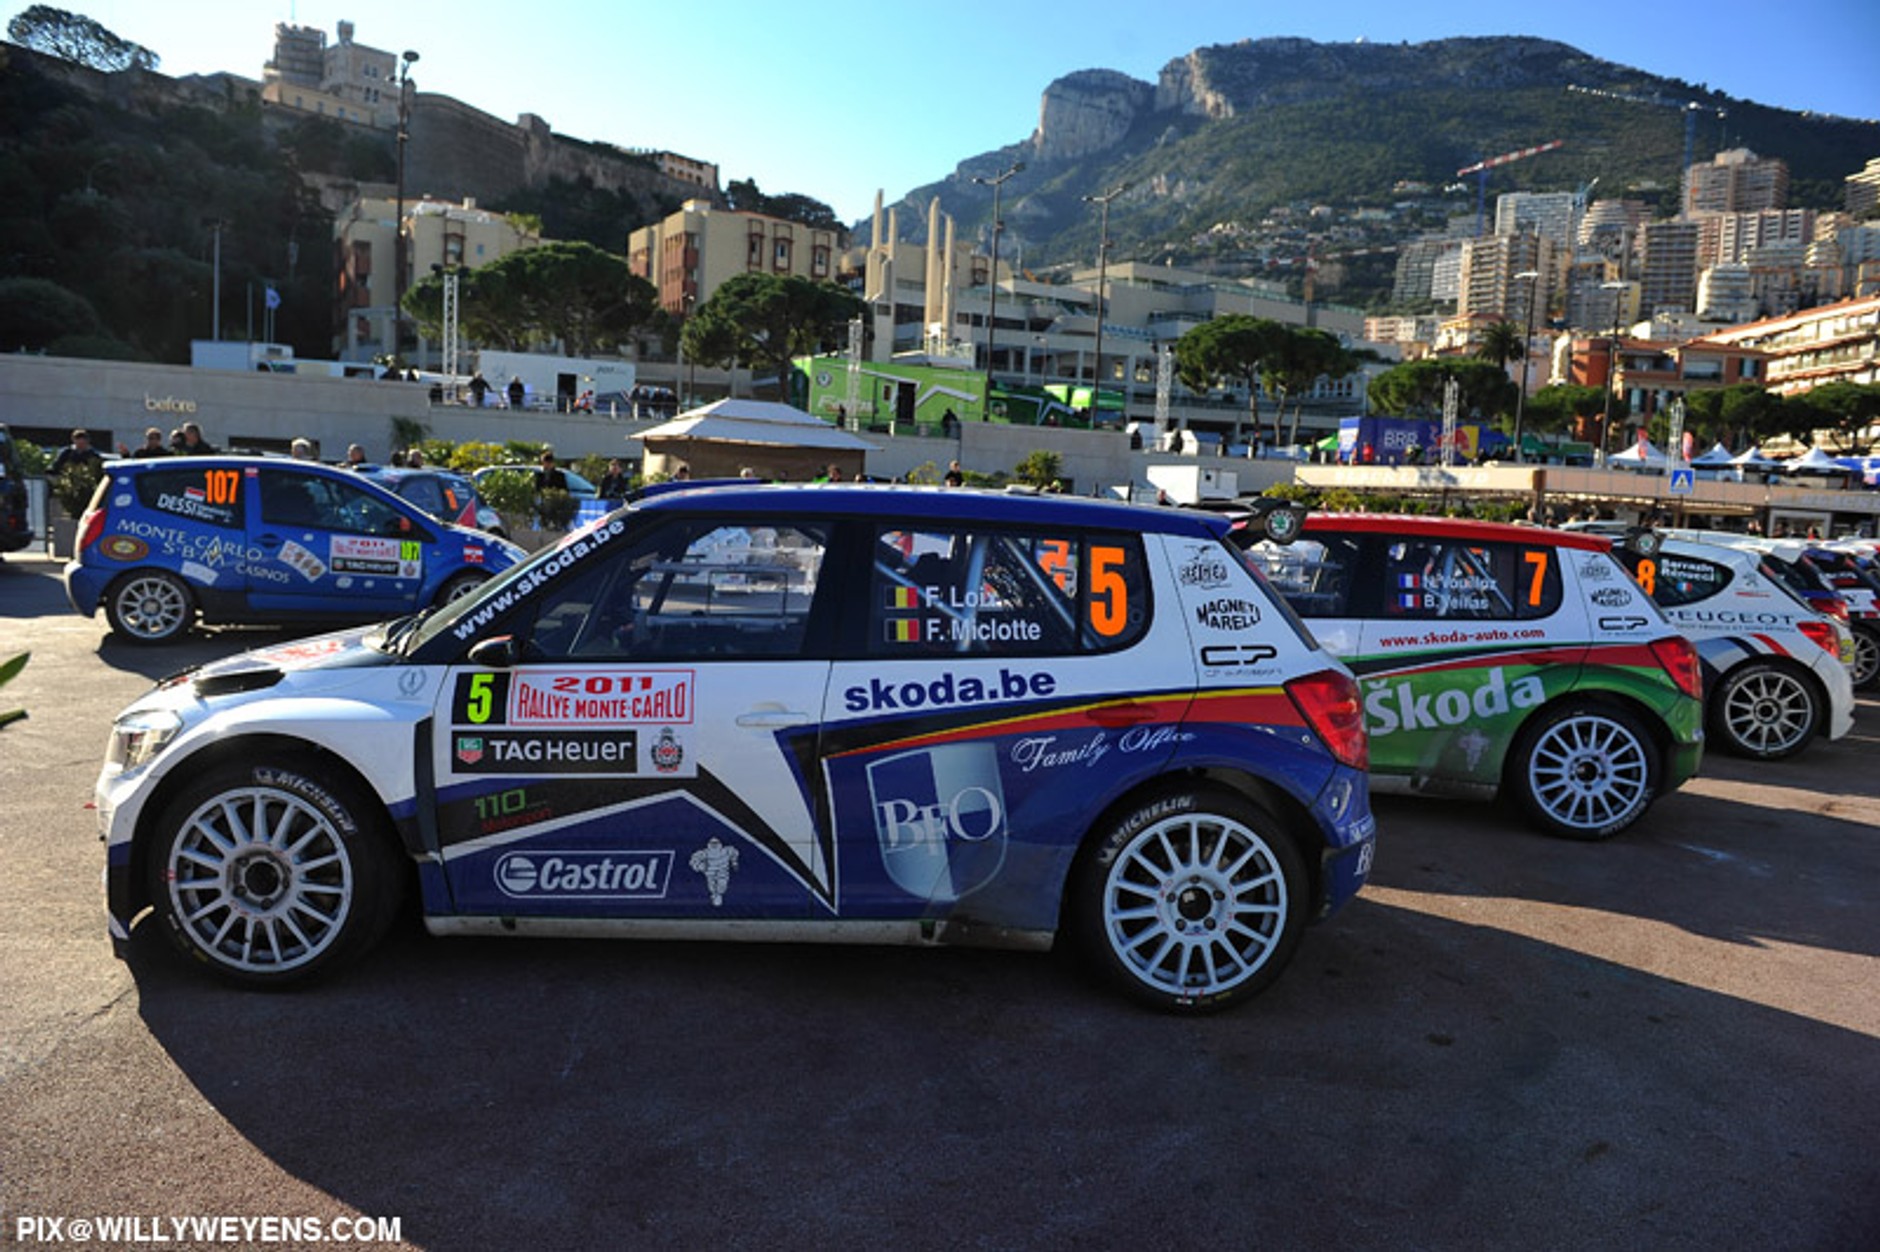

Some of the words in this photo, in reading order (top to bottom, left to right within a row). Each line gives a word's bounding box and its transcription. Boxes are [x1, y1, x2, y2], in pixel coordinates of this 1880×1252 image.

[143, 391, 196, 413] before
[156, 492, 197, 515] DESSI
[204, 470, 240, 505] 107
[234, 562, 291, 584] CASINOS
[452, 520, 626, 641] www.skoda.be
[1090, 545, 1128, 637] 5
[1524, 551, 1548, 607] 7
[1636, 559, 1656, 596] 8
[1423, 594, 1440, 609] B.
[926, 618, 945, 641] F.
[951, 618, 1042, 641] Miclotte
[1379, 627, 1546, 648] www.skoda-auto.com
[466, 672, 495, 724] 5
[517, 682, 570, 720] RALLYE
[573, 681, 687, 720] MONTE-CARLO
[551, 675, 653, 695] 2011
[844, 668, 1056, 712] skoda.be
[1363, 666, 1547, 737] Škoda
[489, 740, 542, 761] TAG
[546, 741, 633, 761] Heuer
[1011, 732, 1112, 772] Family
[1117, 725, 1198, 754] Office
[474, 788, 526, 819] 110
[878, 786, 1001, 856] BFO
[1111, 795, 1193, 845] MICHELIN
[539, 857, 659, 890] Castrol
